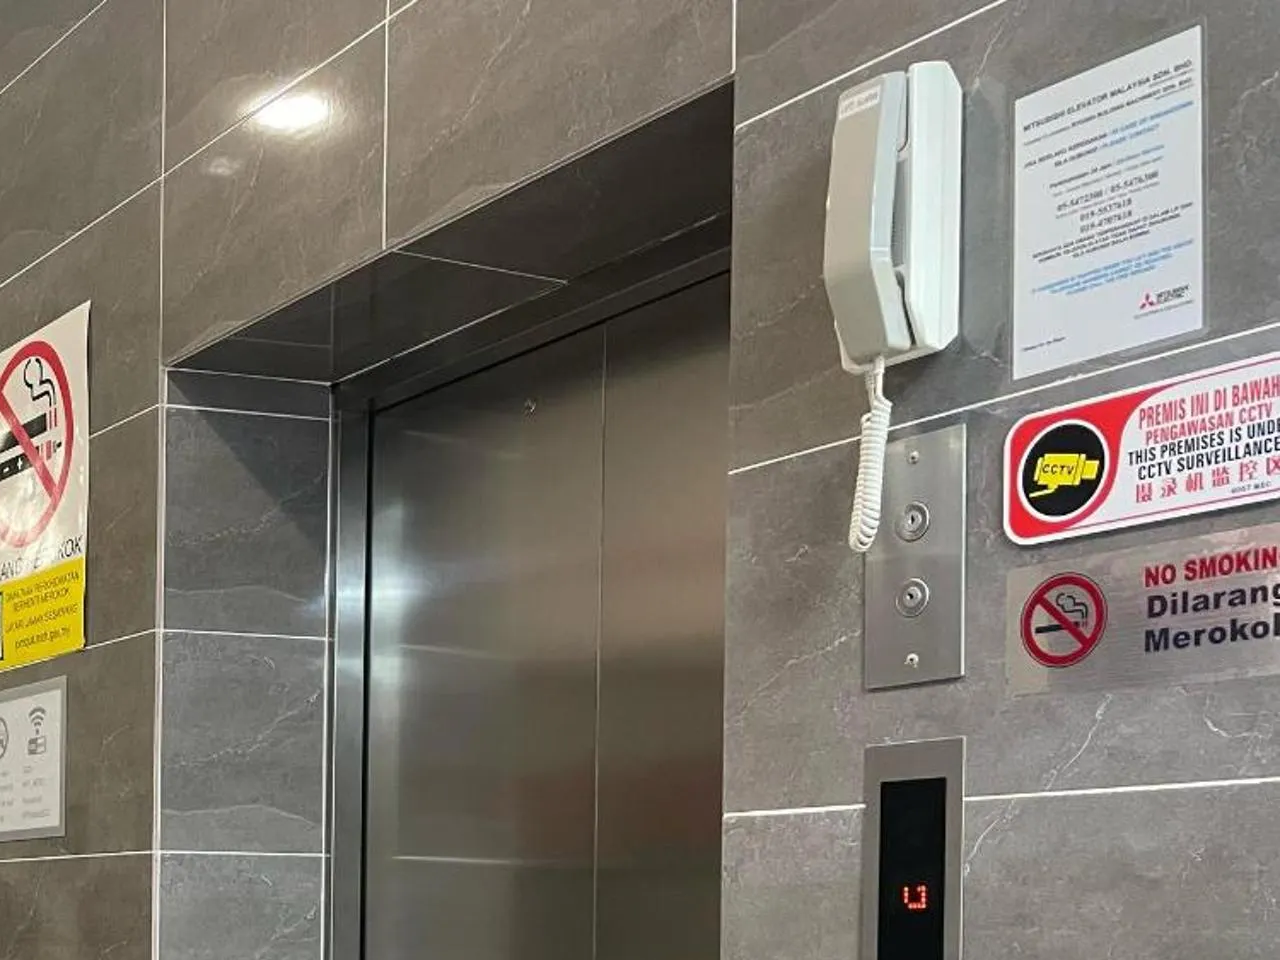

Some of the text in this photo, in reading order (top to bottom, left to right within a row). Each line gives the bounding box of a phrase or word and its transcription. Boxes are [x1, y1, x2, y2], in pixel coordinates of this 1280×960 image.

[1139, 398, 1186, 429] PREMIS
[1191, 392, 1209, 417] INI
[1214, 388, 1227, 412] DI
[1145, 402, 1272, 445] PENGAWASAN CCTV
[1128, 447, 1156, 466] THIS
[1160, 431, 1224, 458] PREMISES
[1229, 426, 1242, 444] IS
[1138, 436, 1280, 480] CCTV SURVEILLANCE
[1042, 463, 1074, 474] CCTV
[1145, 546, 1280, 587] NO SMOKIN
